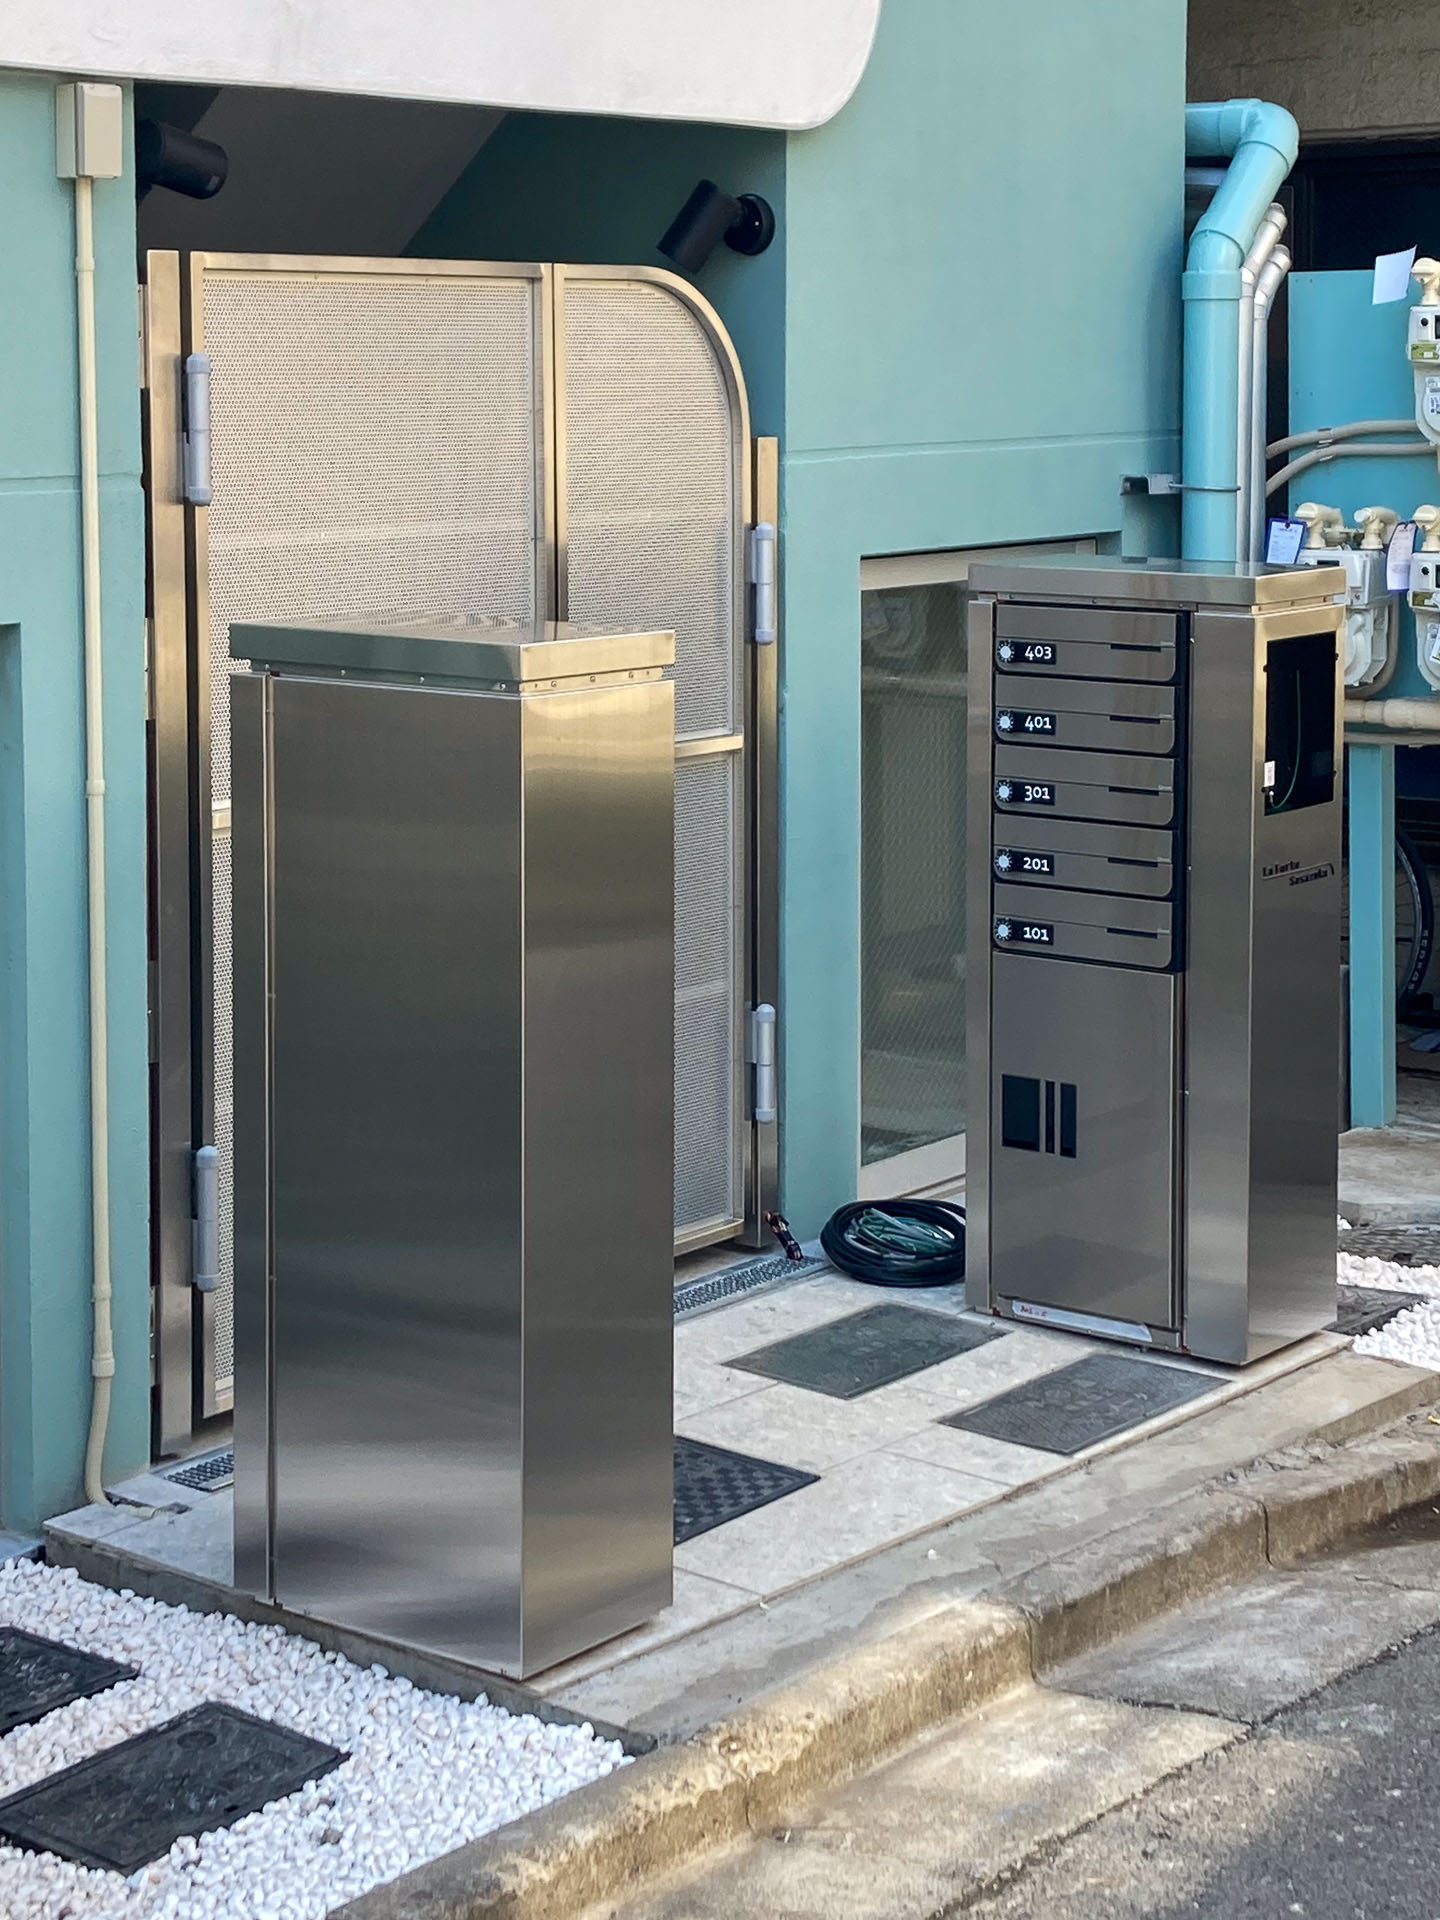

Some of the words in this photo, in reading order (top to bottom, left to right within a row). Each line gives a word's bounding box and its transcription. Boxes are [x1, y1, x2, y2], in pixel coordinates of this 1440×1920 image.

[1024, 645, 1052, 661] 403
[1024, 715, 1052, 732] 401
[1024, 785, 1051, 801] 301
[1023, 857, 1050, 872] 201
[1023, 926, 1050, 941] 101
